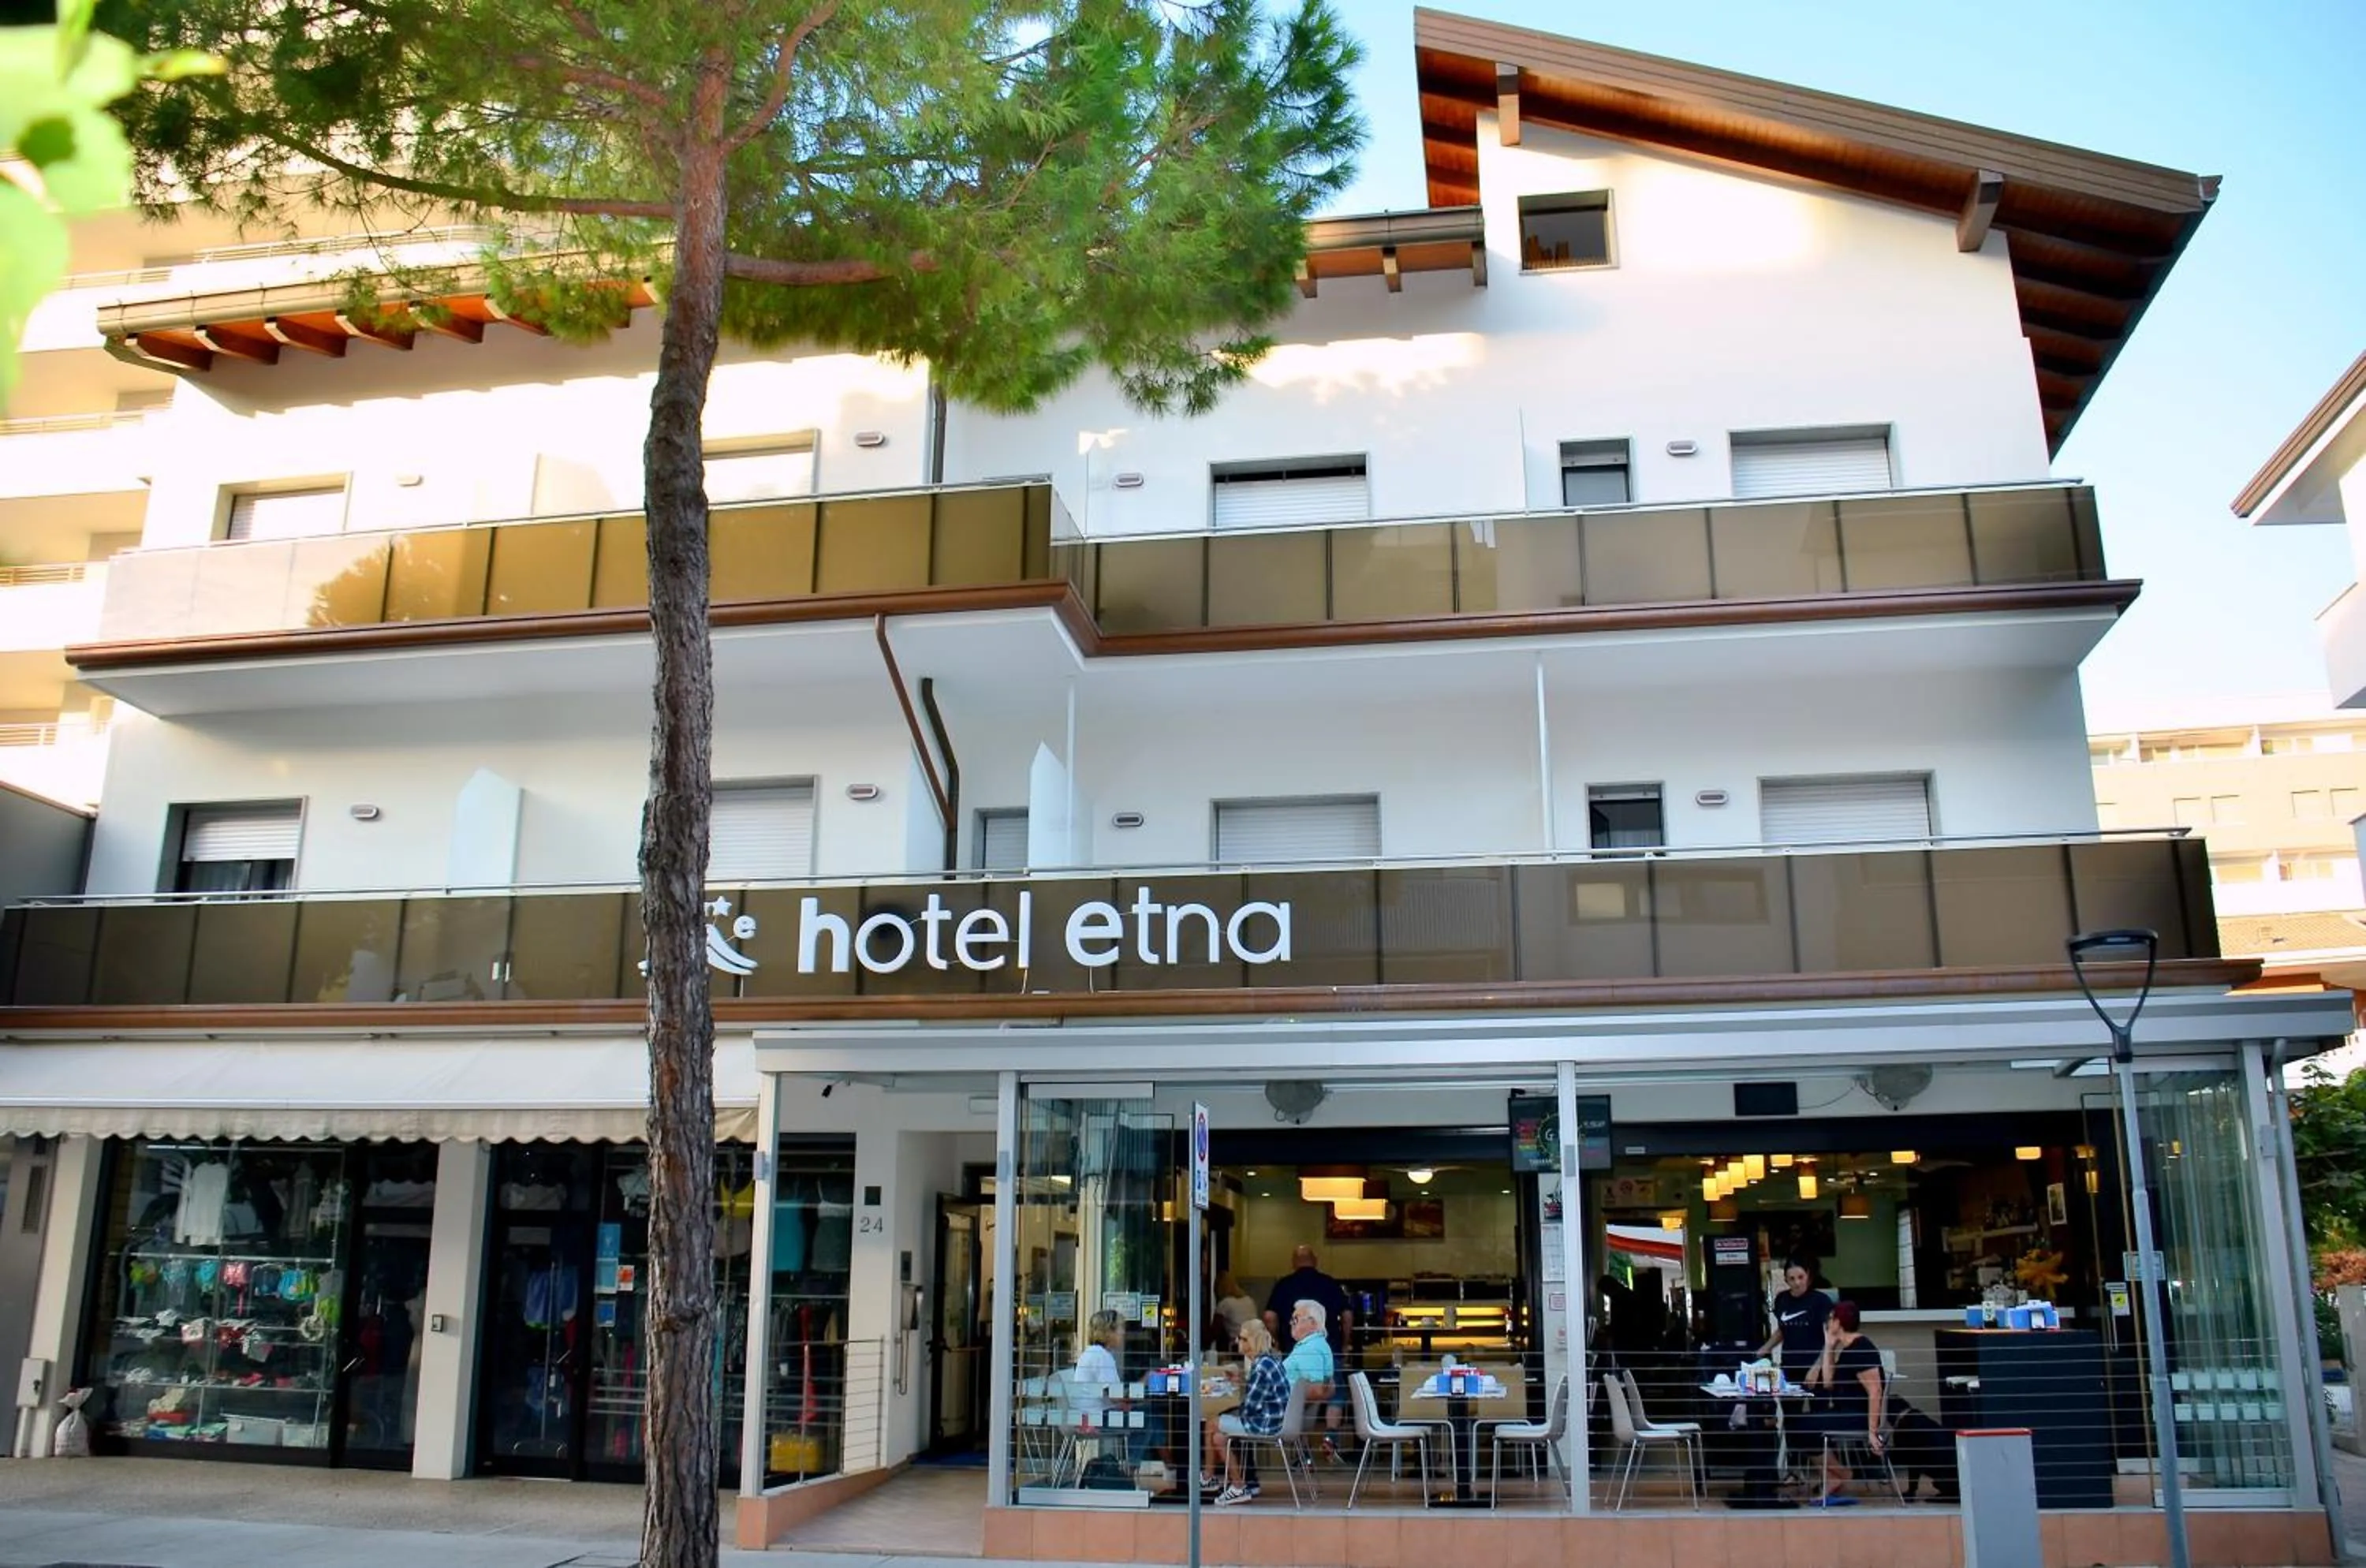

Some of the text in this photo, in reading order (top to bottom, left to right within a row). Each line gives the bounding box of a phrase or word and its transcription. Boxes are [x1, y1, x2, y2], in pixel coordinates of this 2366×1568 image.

[797, 887, 1292, 973] hotel etna
[860, 1215, 883, 1234] 24
